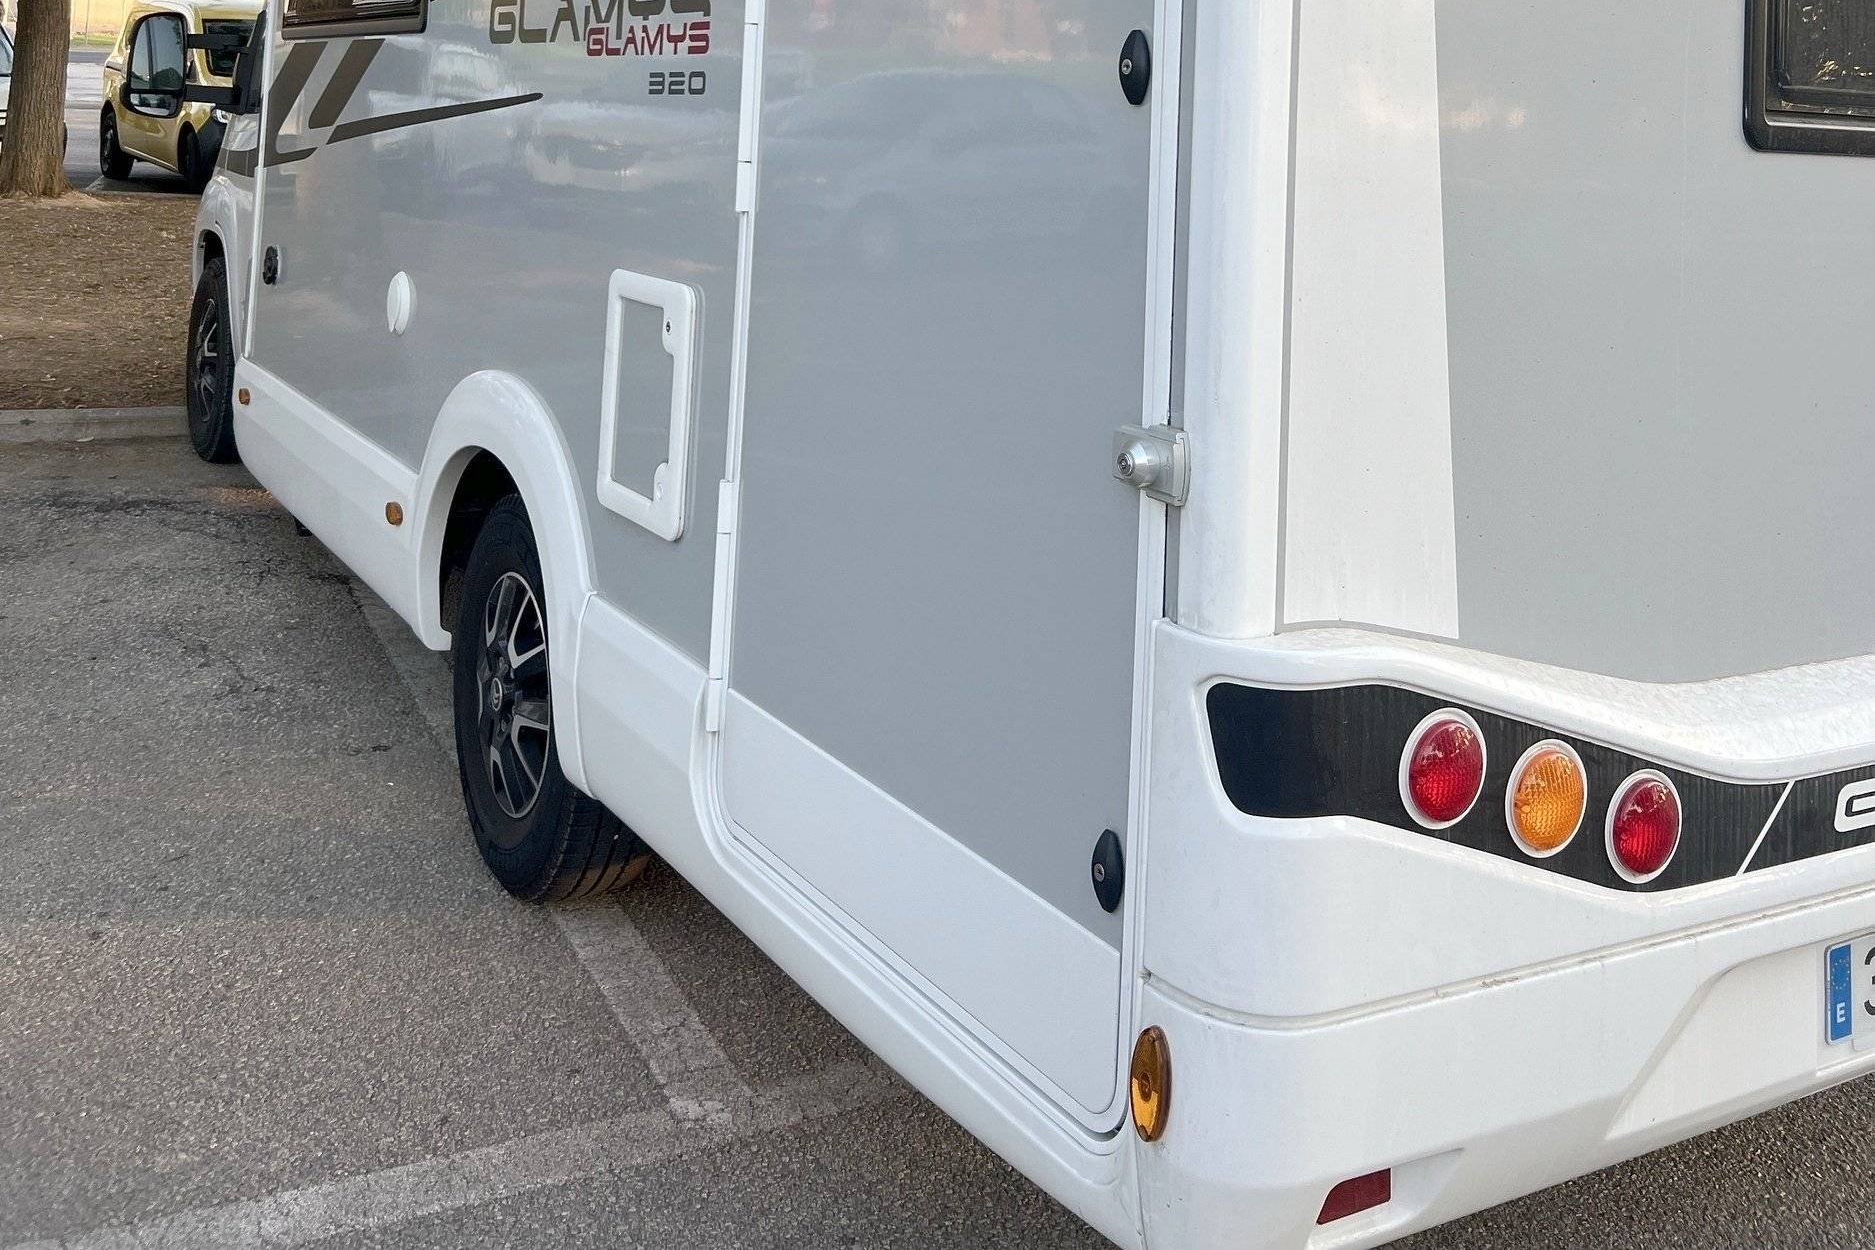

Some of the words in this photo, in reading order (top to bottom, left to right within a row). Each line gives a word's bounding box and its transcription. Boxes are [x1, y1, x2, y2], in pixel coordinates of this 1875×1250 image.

[586, 21, 711, 57] GLAMYS
[648, 71, 706, 95] 320
[1836, 1002, 1846, 1023] E
